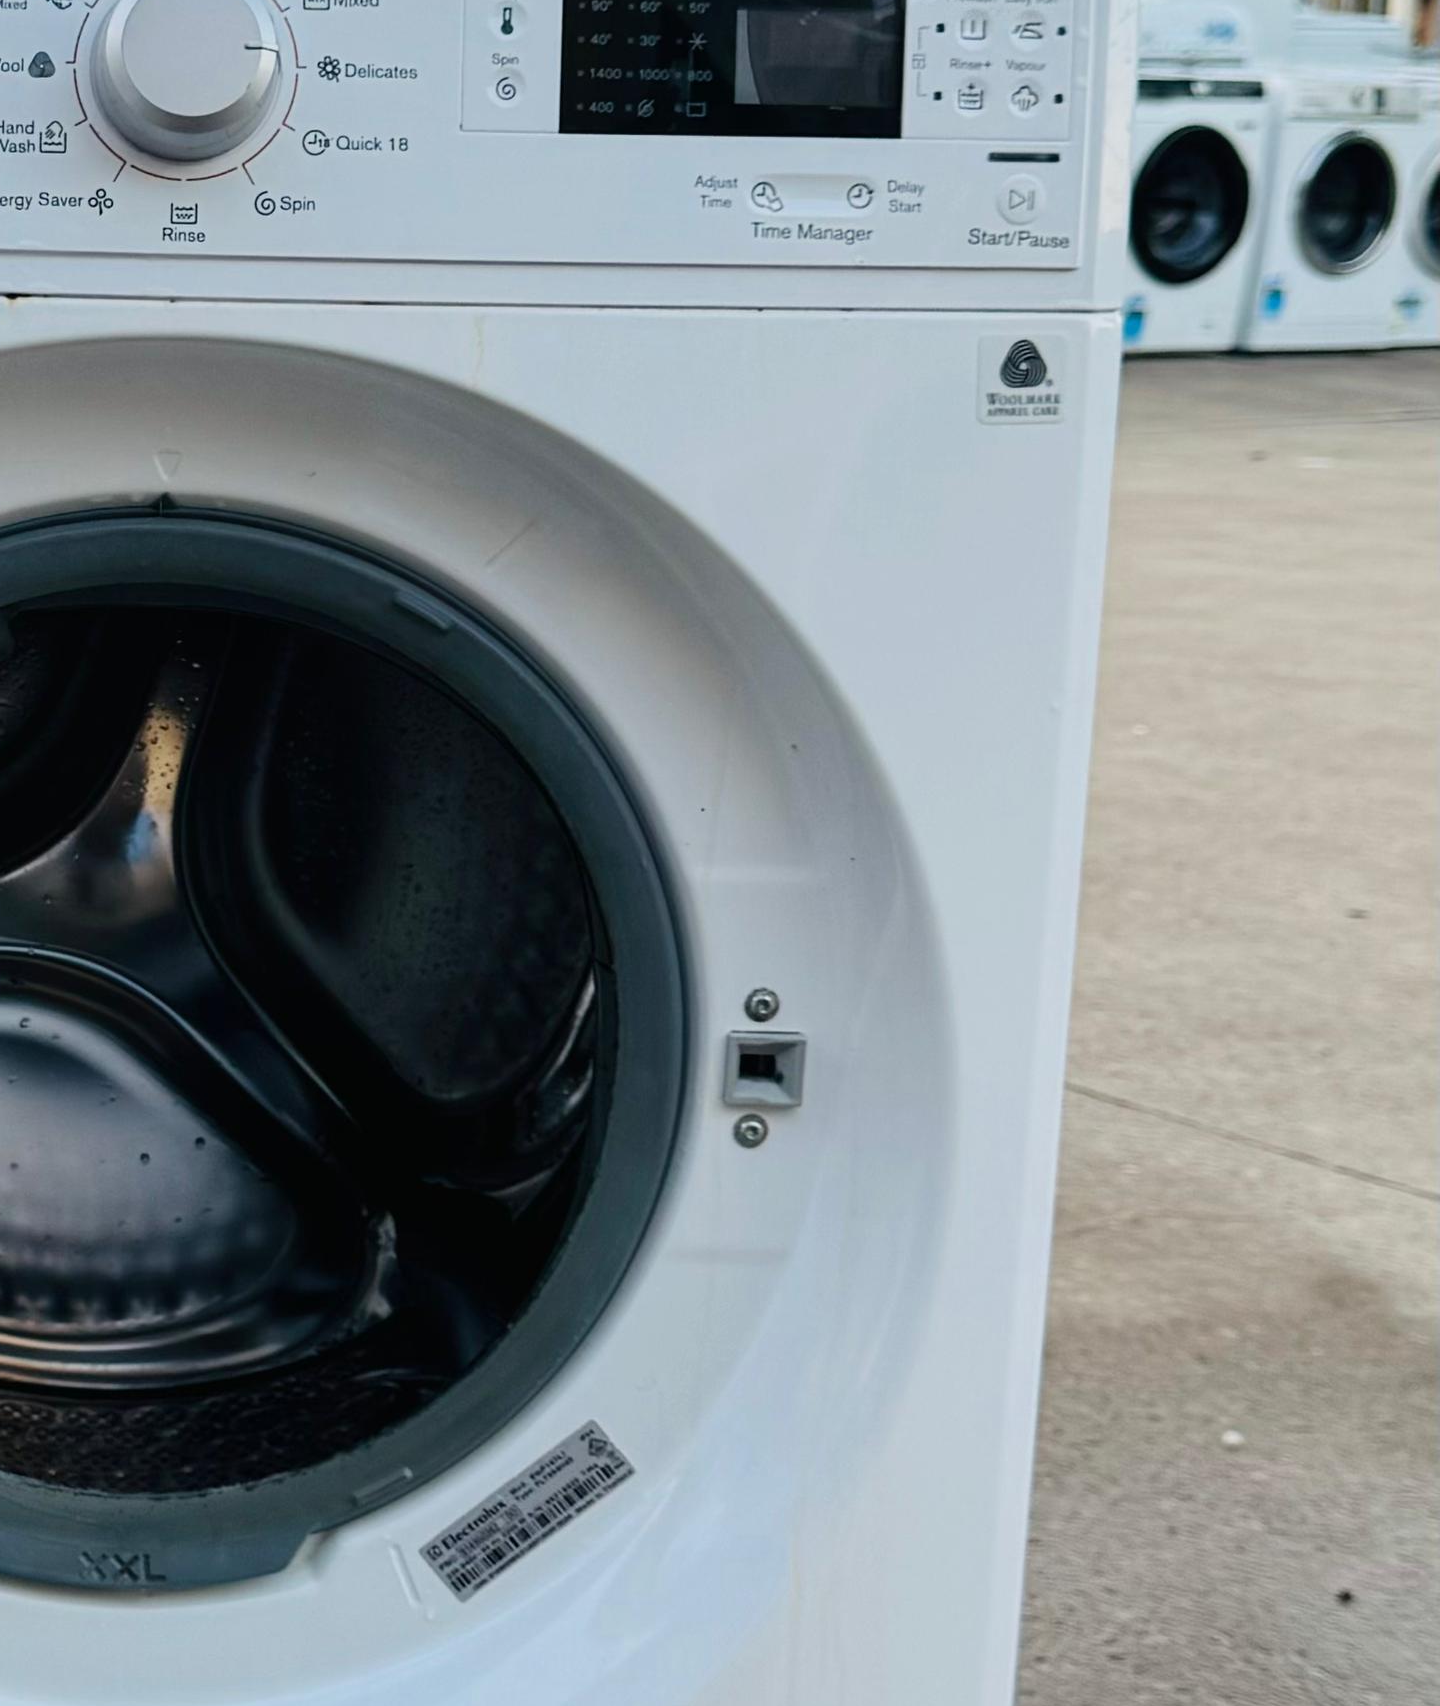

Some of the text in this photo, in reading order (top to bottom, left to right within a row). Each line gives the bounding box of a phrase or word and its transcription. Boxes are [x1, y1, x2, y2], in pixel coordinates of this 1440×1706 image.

[491, 53, 520, 66] Spin
[1005, 59, 1047, 72] Vapour
[344, 63, 418, 80] Delicates
[589, 68, 623, 80] 1400
[638, 69, 670, 81] 1000
[588, 102, 614, 114] 400
[335, 134, 383, 152] Quick
[389, 137, 410, 152] 18
[694, 174, 739, 192] Adjust
[887, 179, 926, 198] Delay
[37, 193, 84, 210] Saver
[279, 196, 317, 215] Spin
[700, 195, 733, 210] Time
[888, 199, 922, 214] Start
[161, 226, 207, 244] Rinse
[751, 221, 875, 246] Time Manager
[967, 228, 1071, 249] Start/Pause
[441, 1500, 508, 1551] Electrolux
[78, 1551, 168, 1583] XXL
